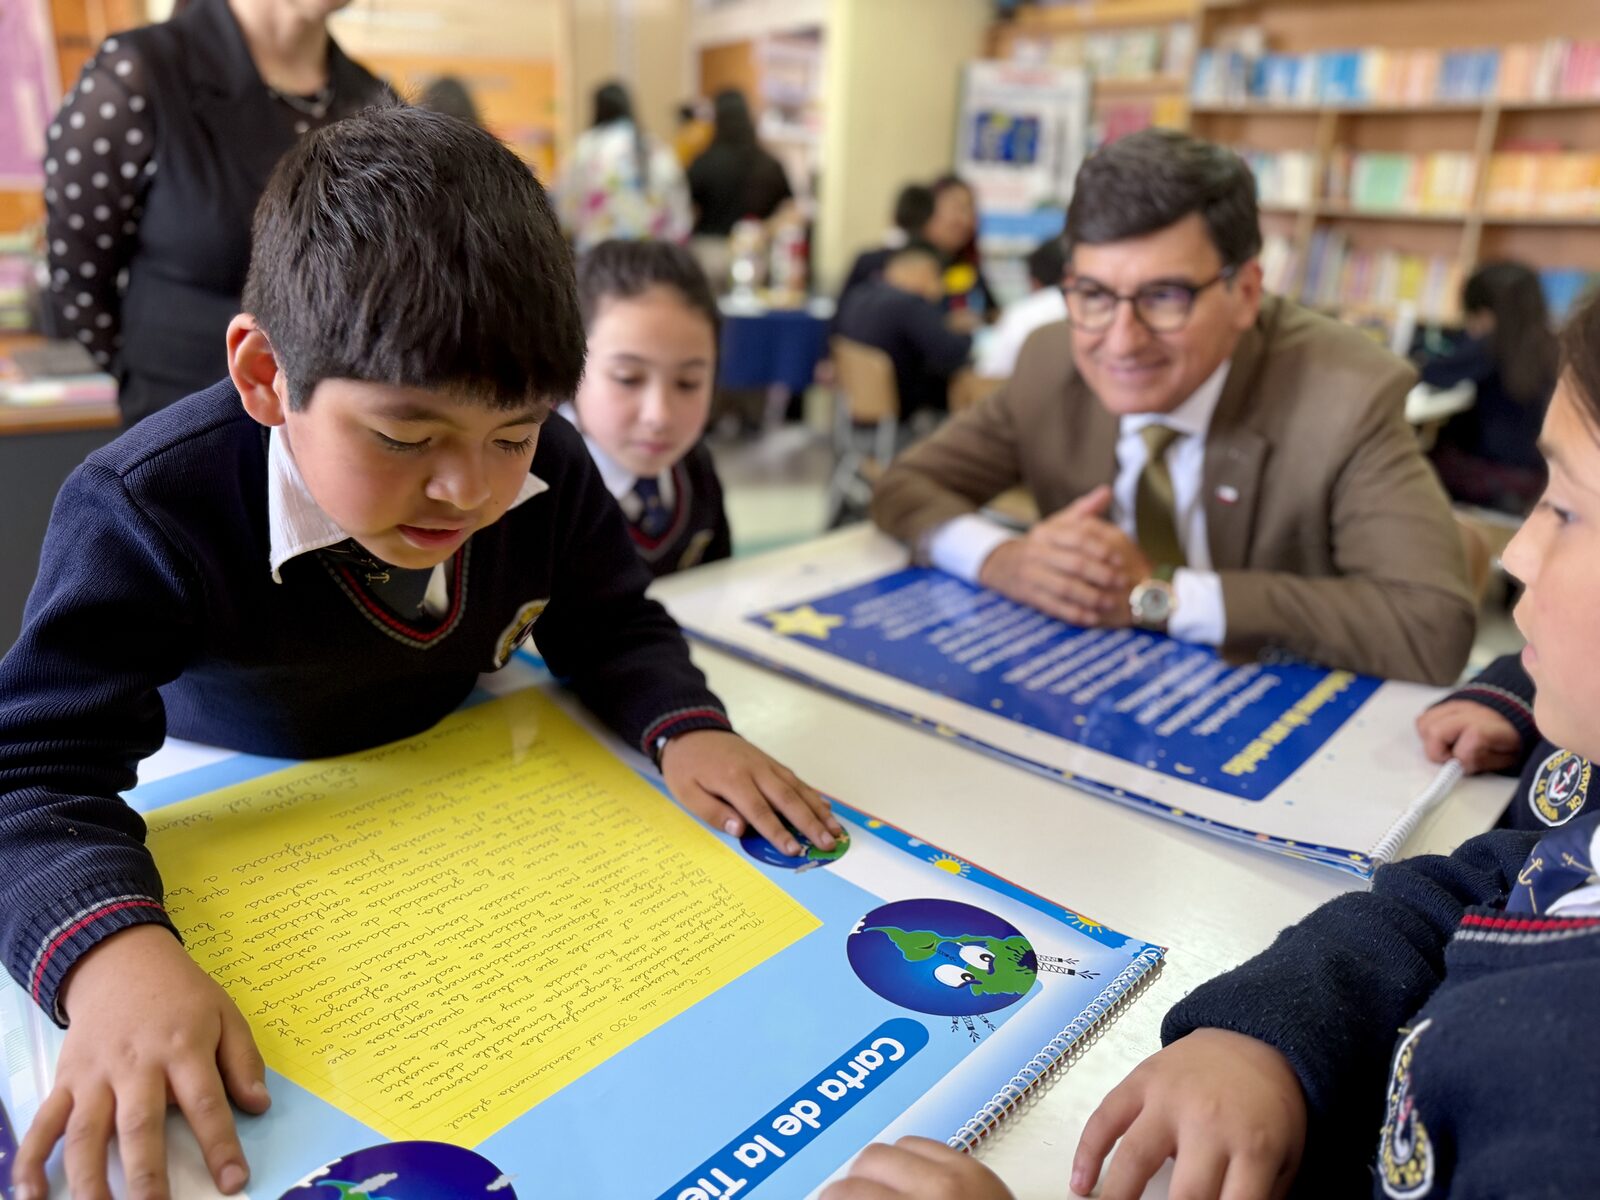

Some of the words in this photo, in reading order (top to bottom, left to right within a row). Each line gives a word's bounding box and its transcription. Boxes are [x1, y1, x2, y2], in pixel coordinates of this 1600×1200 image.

[386, 826, 446, 852] nuestro
[416, 841, 447, 855] mis
[230, 833, 340, 873] beneficiará
[272, 829, 383, 873] esperanzada
[326, 848, 385, 876] futuro
[400, 839, 486, 877] encuentran
[460, 856, 479, 867] de
[496, 856, 515, 866] de
[202, 874, 219, 883] a
[239, 874, 264, 886] en
[342, 857, 409, 885] médicos
[472, 867, 495, 877] la
[496, 871, 515, 881] de
[536, 865, 570, 882] aún,
[555, 871, 581, 888] por
[581, 864, 630, 889] ustedes,
[598, 868, 649, 894] acuerdo,
[195, 885, 230, 903] que
[243, 878, 318, 910] volverá
[357, 879, 395, 895] más
[364, 867, 459, 908] tratamiento
[618, 870, 672, 898] analizan
[628, 882, 666, 907] jamás
[707, 882, 729, 900] fiel
[244, 887, 338, 924] tratantes.
[387, 876, 465, 917] gravedad
[416, 882, 489, 916] consuelo,
[477, 885, 530, 911] ustedes
[489, 889, 552, 920] sanarme
[548, 892, 574, 906] mis
[569, 895, 592, 910] que
[602, 897, 616, 906] y
[638, 889, 689, 915] honesta
[727, 901, 744, 910] mi
[218, 910, 235, 919] a
[241, 896, 351, 944] explicitados
[329, 908, 358, 924] que
[359, 916, 380, 927] de
[543, 912, 564, 923] mi
[612, 908, 624, 916] a
[646, 898, 703, 931] servidora
[674, 892, 735, 929] informarles
[718, 907, 756, 929] Junto
[432, 917, 484, 947] podría
[457, 908, 545, 949] habitantes,
[540, 907, 600, 939] chequean
[582, 916, 609, 932] esta
[618, 917, 634, 930] al
[672, 909, 724, 943] profundo
[738, 917, 765, 930] Mis
[262, 924, 324, 952] ustedes
[325, 929, 351, 941] mi
[336, 920, 410, 953] todavía
[346, 913, 469, 972] desaparecerían
[490, 925, 538, 949] estado
[565, 928, 613, 955] decirles
[621, 934, 640, 945] no
[650, 928, 671, 942] que
[692, 931, 715, 945] con
[207, 945, 233, 958] en
[256, 943, 317, 972] estado
[468, 951, 484, 961] es
[510, 932, 578, 968] instancia,
[594, 948, 618, 960] ha
[615, 943, 647, 963] desde
[621, 944, 667, 972] aprecio.
[680, 932, 735, 966] respetados
[379, 949, 432, 972] hasta
[424, 954, 448, 967] no
[425, 940, 536, 998] constantemente
[534, 956, 559, 972] que
[591, 963, 612, 976] un
[628, 946, 689, 983] saludarles
[693, 965, 711, 977] La
[221, 975, 252, 988] ha
[249, 955, 327, 992] estamos
[382, 964, 462, 1003] realmente
[398, 970, 417, 979] se
[470, 968, 504, 990] pero
[542, 962, 588, 989] estado
[247, 975, 336, 1016] conmigo.
[314, 970, 373, 1003] perecer
[474, 974, 533, 1003] hubiese
[542, 977, 590, 1003] tiempo
[577, 976, 622, 998] Tengo
[611, 982, 624, 992] y
[616, 967, 680, 1005] huéspedes:
[660, 977, 698, 996] Tierra,
[289, 1003, 309, 1014] y
[304, 982, 389, 1024] esfuerzan
[440, 992, 470, 1006] los
[498, 992, 535, 1011] muy
[525, 1004, 537, 1013] a
[559, 999, 574, 1013] el
[638, 998, 657, 1011] día
[262, 1017, 290, 1028] lo
[319, 1006, 375, 1034] crítico
[341, 999, 420, 1039] declaran,
[364, 1008, 434, 1045] expertos
[402, 1006, 465, 1040] querido,
[457, 1016, 497, 1035] bien
[491, 1014, 521, 1032] esta
[519, 995, 608, 1047] manifestarles
[608, 1013, 638, 1032] 930
[276, 1026, 296, 1037] y
[292, 1036, 312, 1047] y
[471, 1012, 557, 1059] lamentable
[584, 1031, 603, 1046] del
[310, 1042, 335, 1056] en
[372, 1044, 397, 1057] no
[429, 1038, 449, 1050] de
[445, 1030, 486, 1057] parte
[494, 1049, 513, 1060] de
[326, 1047, 357, 1064] que
[365, 1055, 421, 1084] salud.
[378, 1060, 439, 1094] vuestra
[421, 1061, 464, 1086] deber
[496, 1045, 581, 1096] calentamiento
[816, 1037, 906, 1102] Carta
[393, 1089, 414, 1102] de
[408, 1063, 488, 1110] antemano
[771, 1099, 822, 1136] de
[733, 1134, 786, 1168] la
[676, 1167, 748, 1200] Tie
